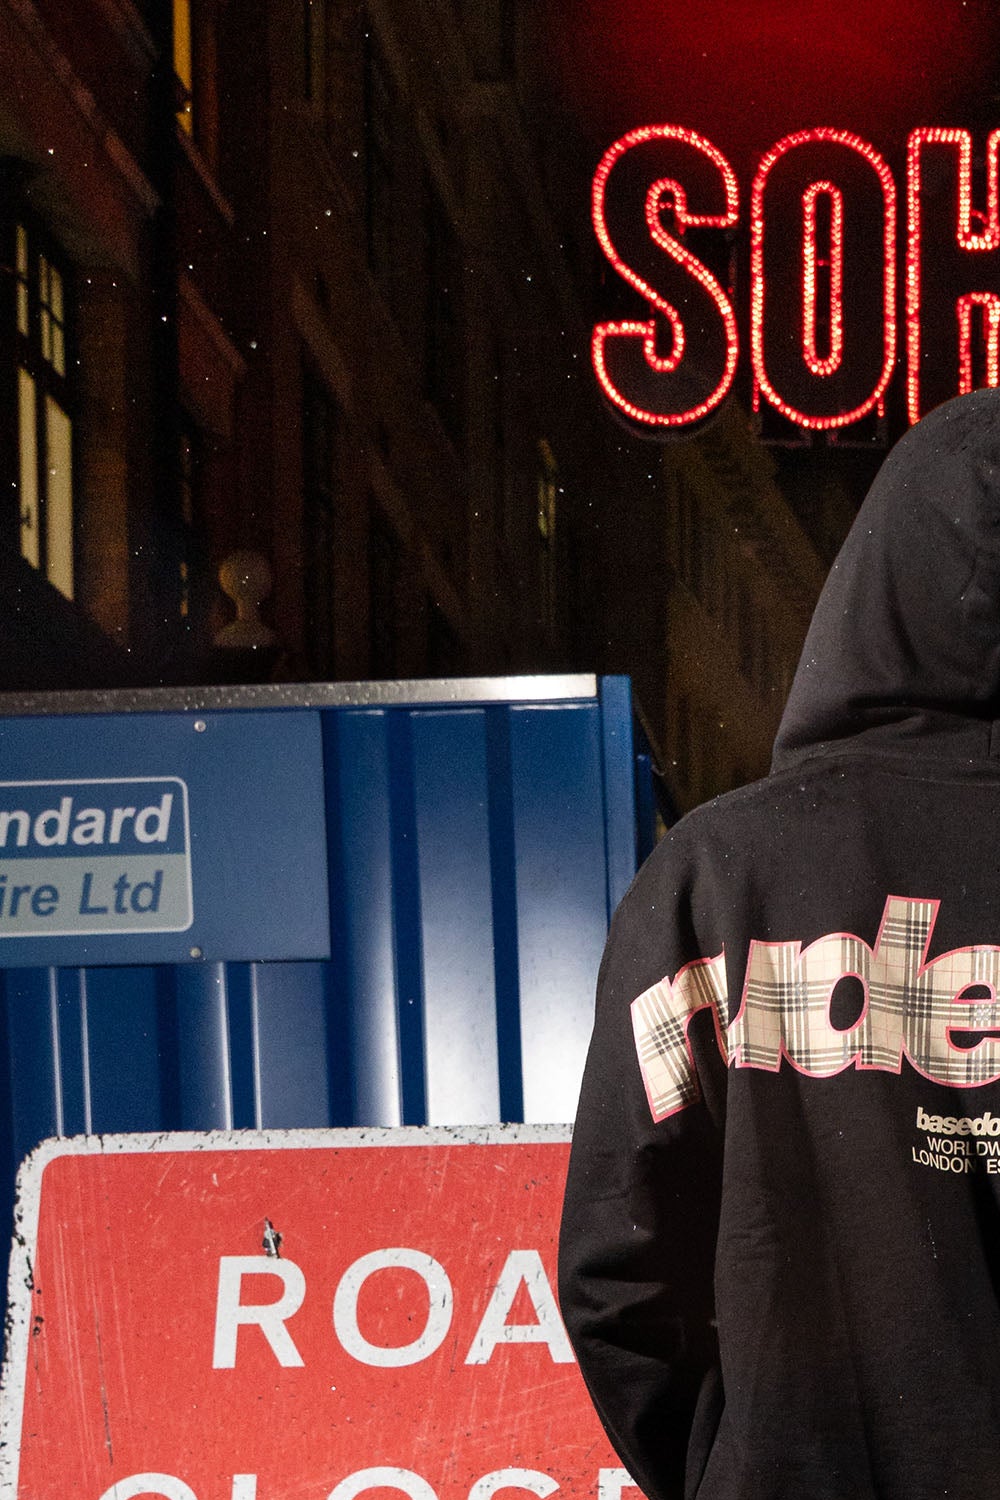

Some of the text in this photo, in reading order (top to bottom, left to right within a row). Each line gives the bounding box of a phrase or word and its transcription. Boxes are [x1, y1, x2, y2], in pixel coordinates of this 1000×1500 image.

[0, 793, 174, 847] ndard
[79, 869, 164, 916] Ltd
[911, 1146, 977, 1175] LONDON
[212, 1247, 577, 1370] ROA
